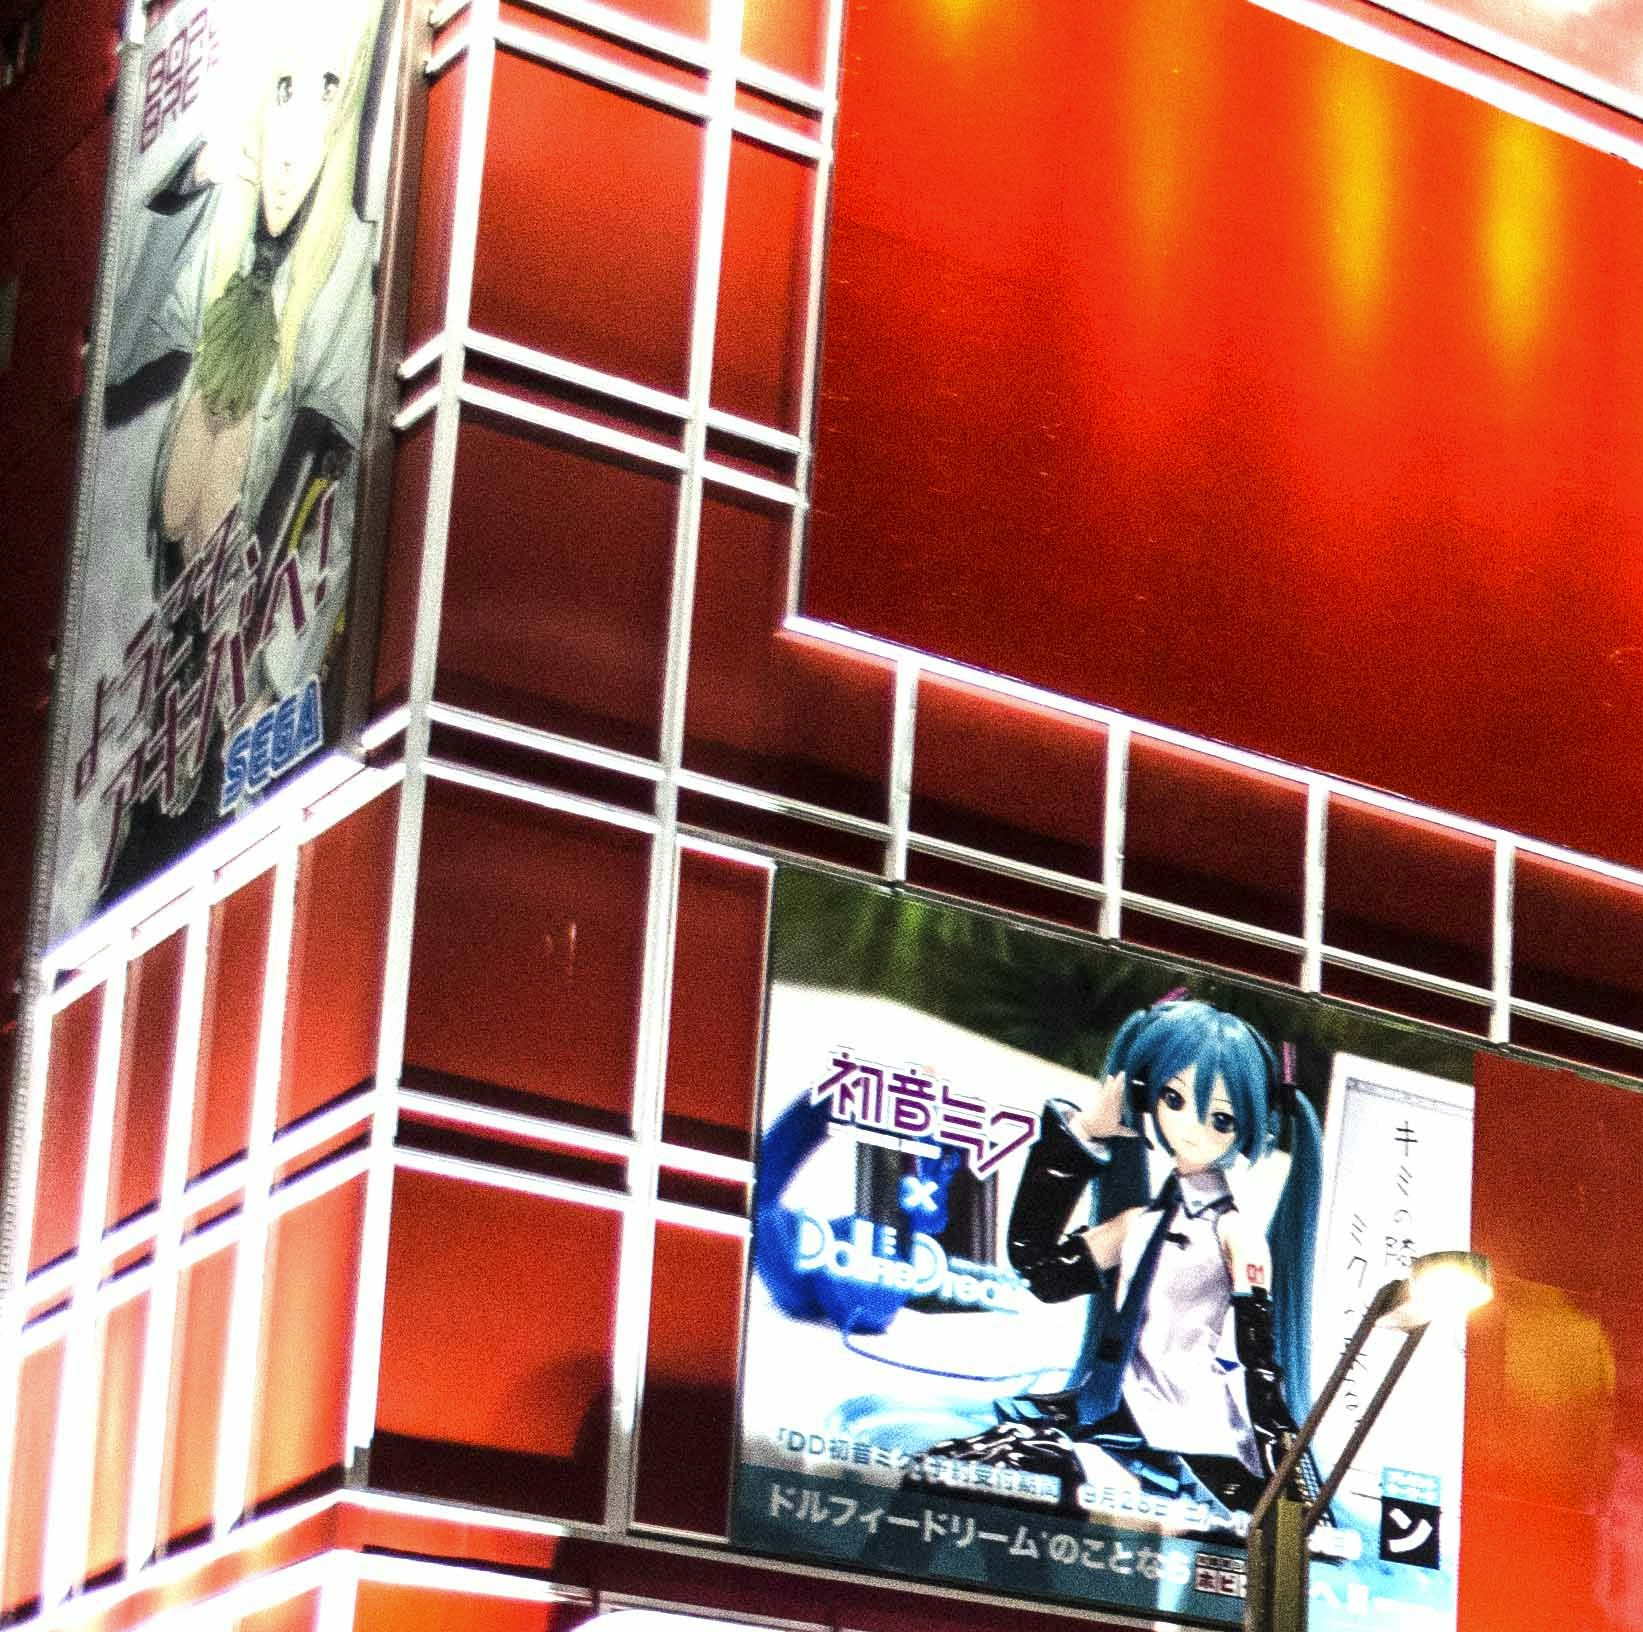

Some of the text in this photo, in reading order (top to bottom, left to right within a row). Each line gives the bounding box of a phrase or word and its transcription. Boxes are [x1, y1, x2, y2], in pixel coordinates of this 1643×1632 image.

[220, 673, 324, 816] SEGA
[814, 1050, 1038, 1177] 初音ミク
